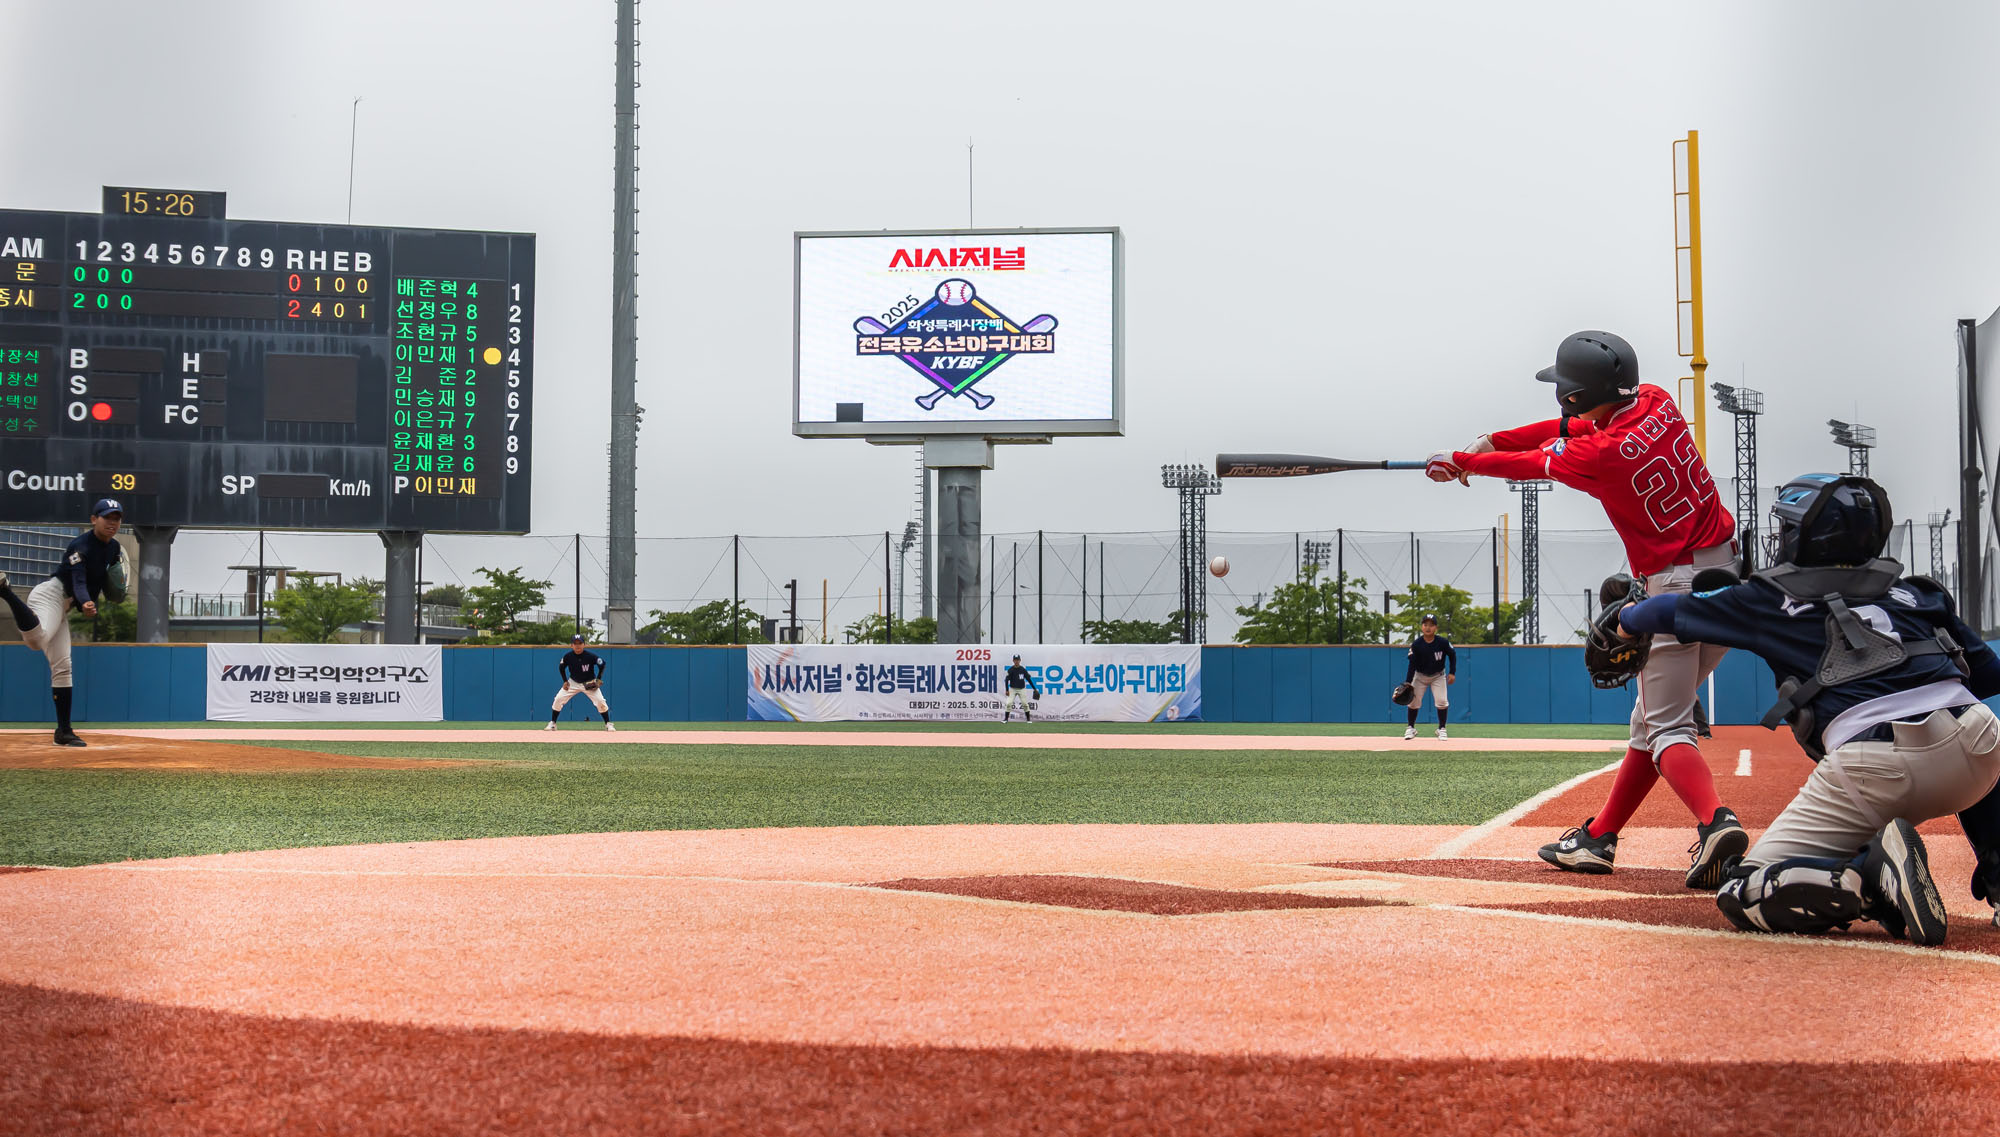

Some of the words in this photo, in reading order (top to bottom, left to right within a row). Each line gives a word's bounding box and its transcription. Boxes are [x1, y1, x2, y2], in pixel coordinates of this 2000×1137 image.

[121, 191, 195, 216] 15:26
[888, 247, 1025, 271] 시사저널
[466, 282, 478, 298] 4
[511, 283, 521, 301] 1
[466, 304, 478, 320] 8
[509, 305, 521, 323] 2
[881, 294, 920, 325] 2025
[466, 326, 477, 342] 5
[907, 319, 1003, 333] 화성특례시장배
[509, 327, 521, 344] 3
[859, 335, 1053, 353] 전국유소년야구대회
[70, 349, 89, 369] B
[183, 352, 200, 373] H
[468, 348, 475, 363] 1
[508, 349, 521, 366] 4
[930, 355, 986, 370] KYBF
[70, 375, 88, 395] S
[465, 369, 476, 386] 2
[508, 370, 520, 388] 5
[182, 379, 199, 399] E
[464, 391, 476, 408] 9
[507, 392, 520, 409] 6
[68, 401, 88, 421] O
[164, 404, 199, 424] FC
[464, 413, 475, 429] 7
[507, 413, 520, 431] 7
[464, 435, 475, 451] 3
[506, 435, 519, 453] 8
[463, 456, 475, 472] 6
[506, 457, 518, 475] 9
[8, 470, 85, 492] Count
[111, 474, 136, 490] 39
[221, 475, 255, 495] SP
[330, 479, 371, 496] Km/h
[395, 476, 409, 494] P
[415, 476, 476, 495] 이민재
[1631, 429, 1716, 533] 22
[956, 649, 991, 661] 2025
[221, 665, 271, 681] KMI
[274, 665, 429, 683] 한국의학연구소
[1004, 663, 1186, 695] 국유소년야구대회
[250, 690, 289, 703] 건강한
[292, 691, 331, 704] 내일을
[336, 691, 401, 704] 응원합니다
[909, 701, 940, 710] 대회기간
